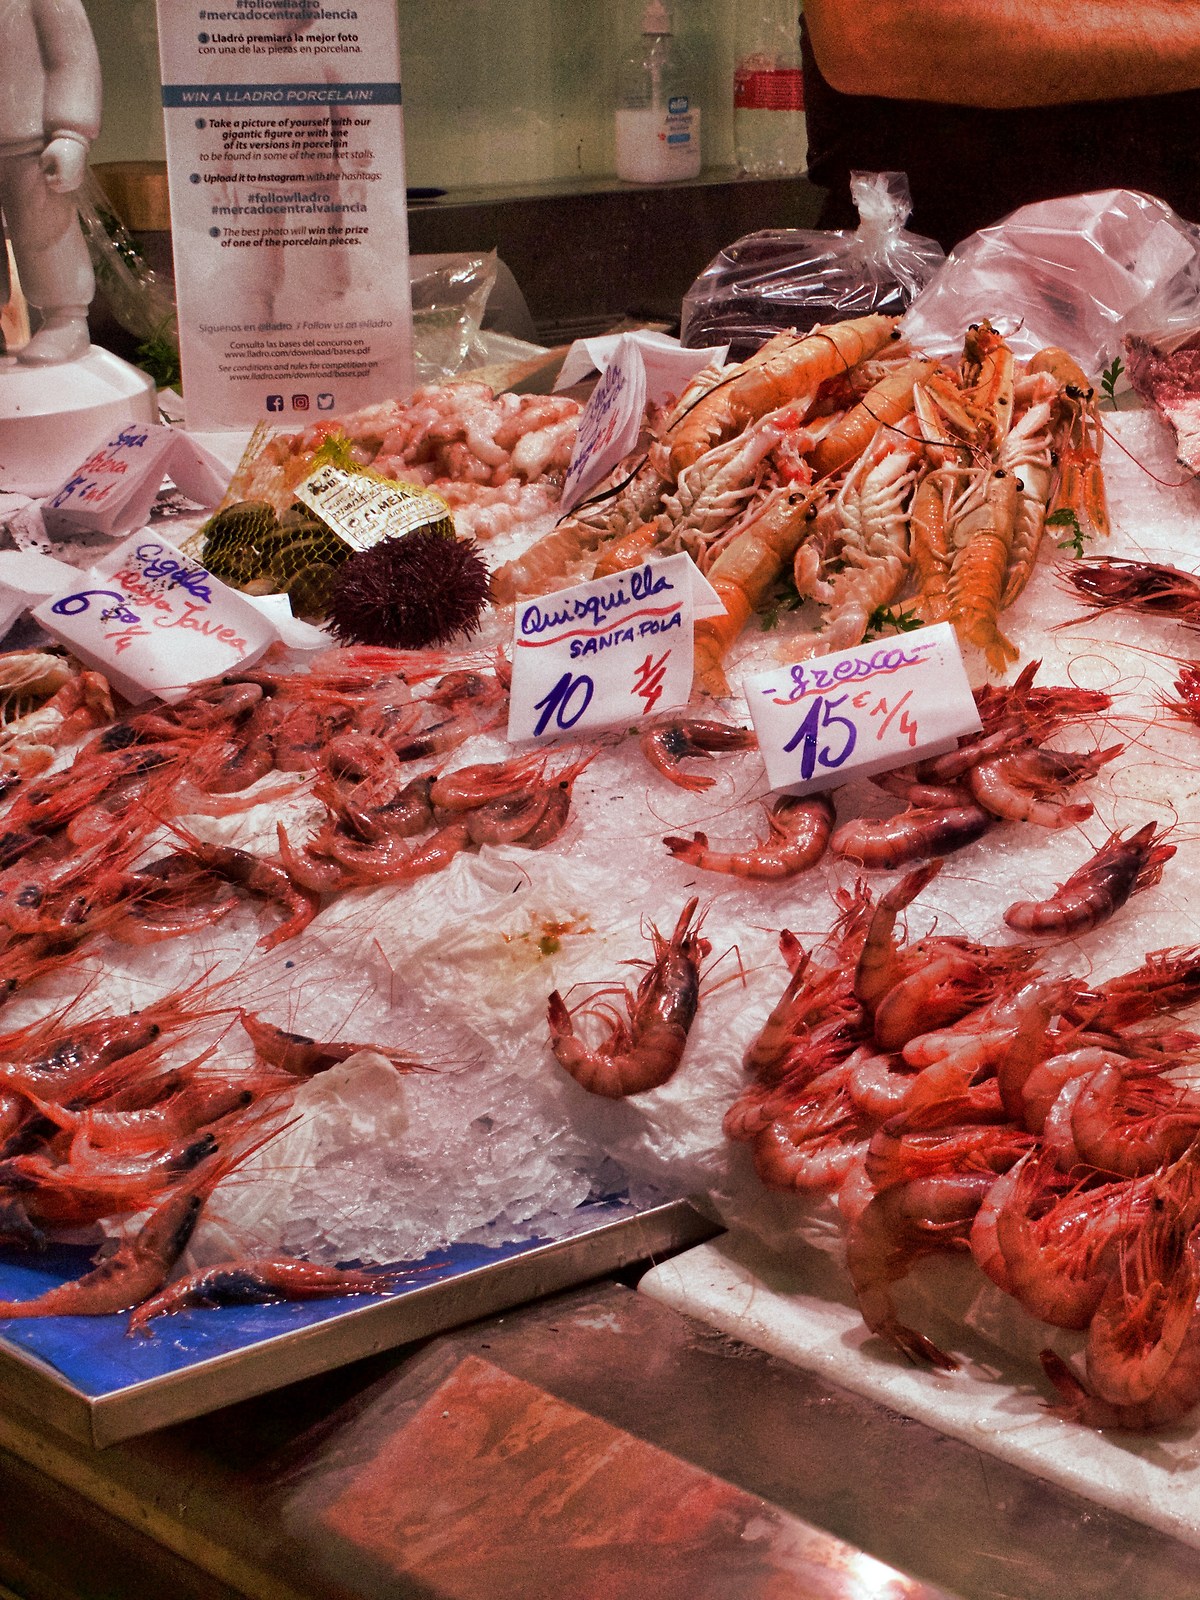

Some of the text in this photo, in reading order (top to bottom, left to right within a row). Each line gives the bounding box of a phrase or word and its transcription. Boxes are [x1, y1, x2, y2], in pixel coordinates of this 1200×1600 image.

[199, 9, 358, 20] #mercadocentralvalencia
[212, 33, 244, 43] Lladró
[246, 33, 293, 45] premiará
[295, 34, 304, 42] la
[306, 33, 336, 44] mejor
[337, 32, 358, 42] foto
[199, 46, 215, 54] con
[218, 46, 237, 54] una
[239, 44, 250, 53] de
[253, 44, 266, 53] las
[268, 45, 298, 55] piezas
[314, 45, 362, 55] porcelana.
[182, 89, 373, 102] WIN A LLADRÓ PORCELAIN!
[209, 119, 232, 128] Take
[241, 119, 276, 129] picture
[278, 118, 289, 129] of
[289, 118, 330, 129] yourself
[331, 118, 352, 126] with
[222, 130, 262, 141] gigantic
[264, 130, 293, 140] figure
[307, 129, 329, 137] with
[223, 139, 348, 150] of its versions in porcelain
[200, 153, 209, 161] to
[211, 152, 222, 161] be
[223, 151, 250, 161] found
[252, 151, 261, 160] in
[289, 151, 300, 161] of
[301, 151, 315, 159] the
[316, 151, 349, 159] market
[350, 150, 375, 159] stalls.
[203, 173, 237, 184] Upload
[238, 174, 246, 182] it
[246, 174, 256, 182] to
[257, 173, 305, 183] Instagram
[306, 173, 326, 181] with
[326, 172, 340, 181] the
[248, 192, 330, 203] #followlladro
[211, 202, 367, 215] #mercadocentralvalencia
[223, 227, 239, 236] The
[240, 227, 259, 236] best
[261, 227, 289, 237] photo
[290, 226, 306, 235] will
[308, 226, 326, 235] win
[328, 226, 342, 235] the
[345, 225, 369, 236] prize
[221, 237, 362, 248] of one of the porcelain pieces.
[302, 322, 331, 330] Follow
[230, 341, 265, 349] Consulta
[266, 340, 277, 348] las
[279, 340, 301, 348] bases
[233, 363, 273, 372] conditions
[274, 363, 289, 371] and
[290, 362, 308, 370] rules
[309, 362, 320, 370] for
[322, 361, 367, 371] competition
[522, 565, 674, 635] Quisquilla
[570, 612, 681, 658] SANTA POLA
[534, 649, 672, 737] 10 1/4
[782, 693, 857, 781] 15
